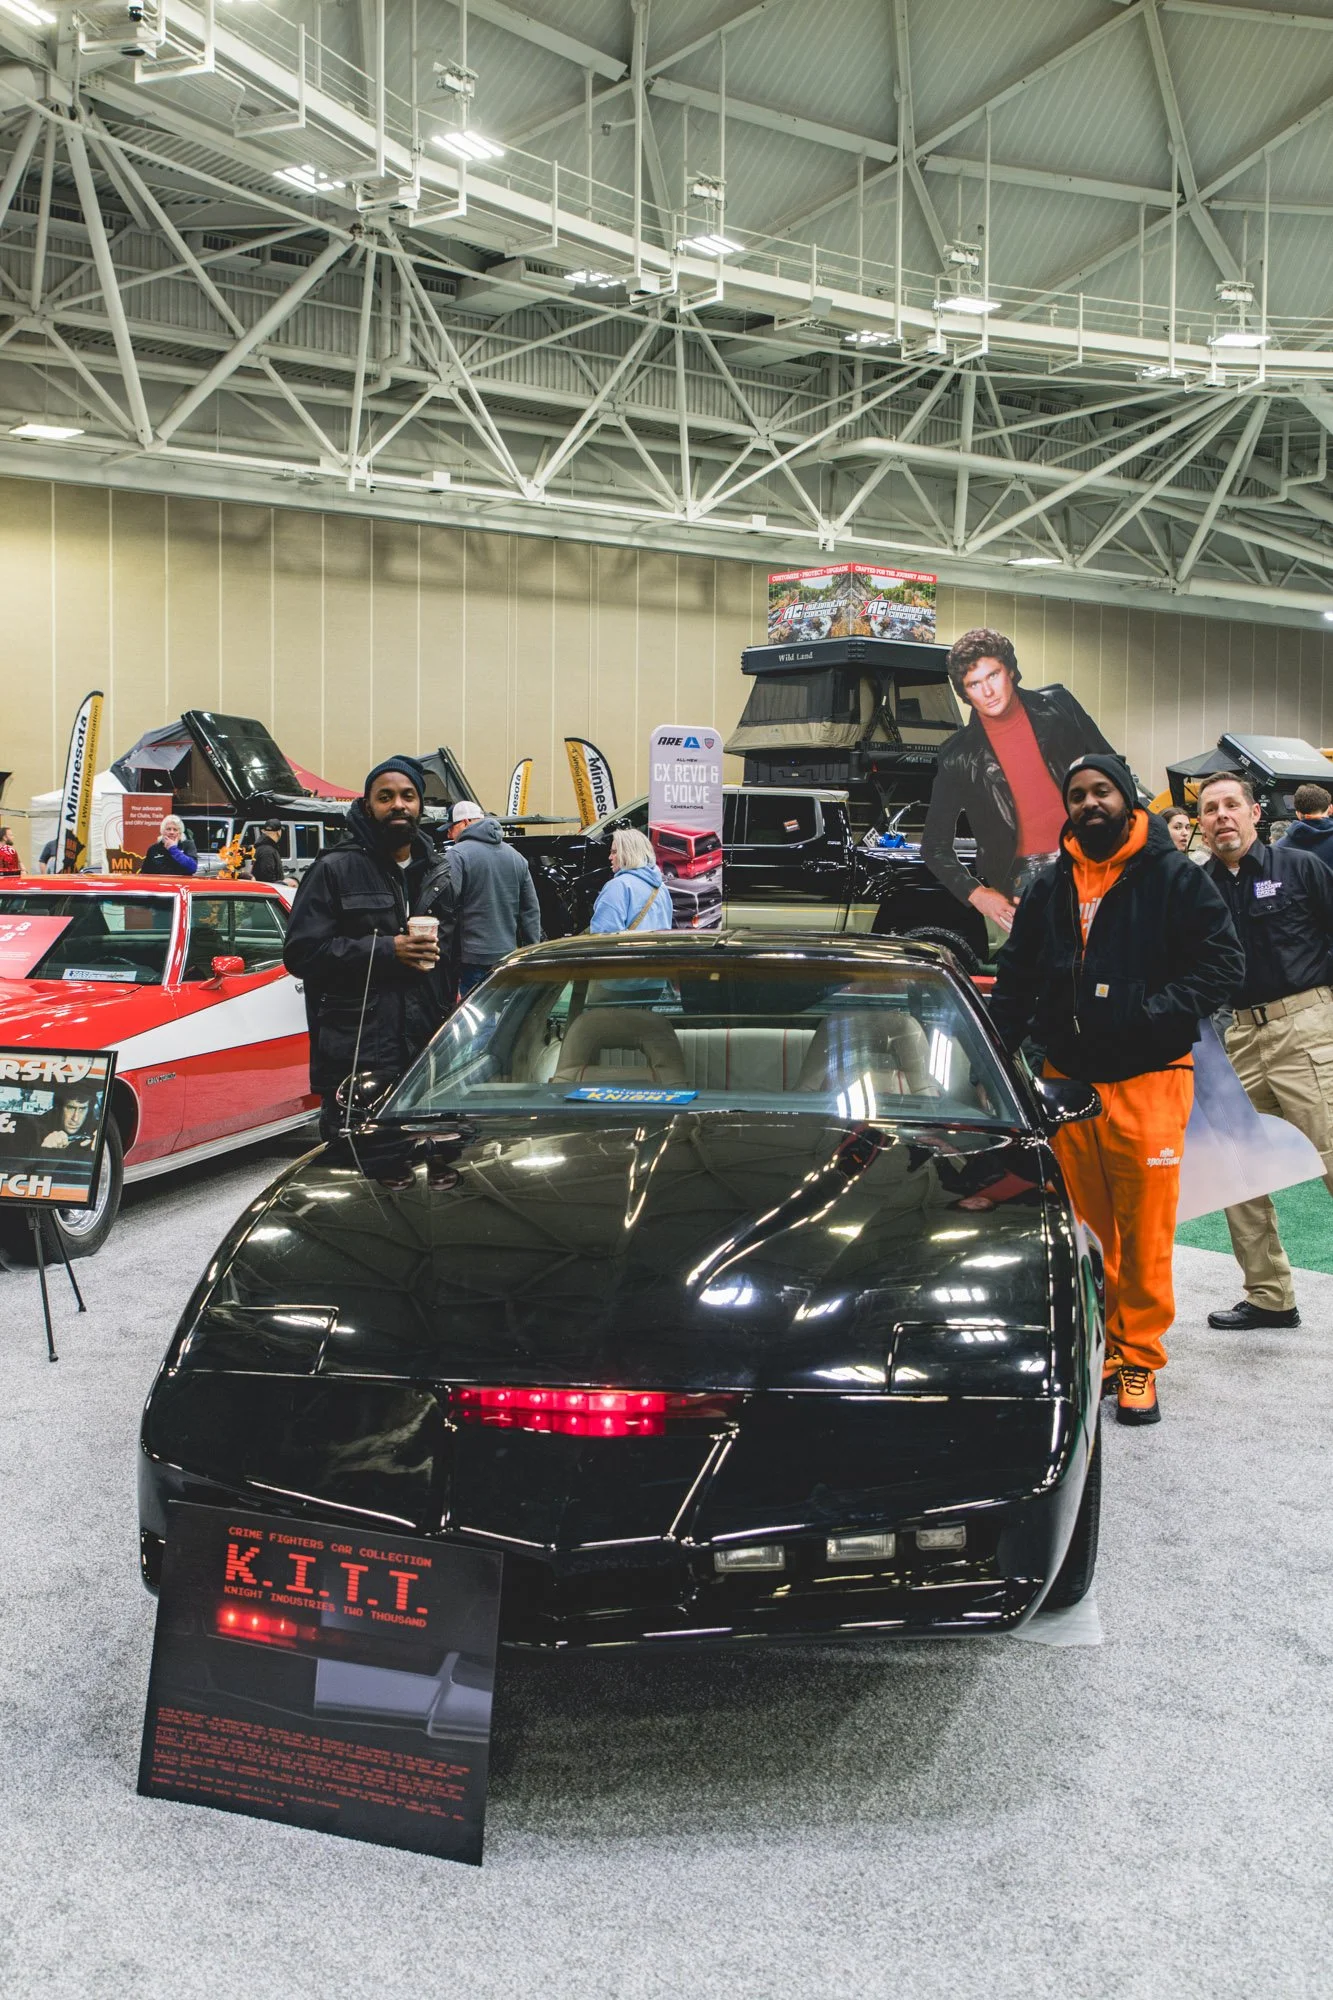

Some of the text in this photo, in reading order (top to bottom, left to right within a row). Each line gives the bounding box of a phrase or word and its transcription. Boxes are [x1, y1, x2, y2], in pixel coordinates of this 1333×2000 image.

[771, 565, 849, 583] CUSTOMIZE PROTECT UPGRADE
[854, 565, 876, 574] CRAFTED
[896, 571, 918, 580] JOURNEY
[917, 574, 934, 582] AHEAD
[778, 651, 814, 662] Wild Land
[658, 737, 684, 747] ARE
[65, 715, 88, 824] Minnesota
[82, 787, 91, 819] Wheel
[90, 705, 99, 761] Association
[572, 755, 581, 777] Wheel
[654, 763, 670, 783] CX
[674, 764, 709, 784] REVO
[576, 777, 585, 797] Drive
[664, 783, 711, 804] EVOLVE
[111, 858, 133, 870] MN
[586, 1092, 681, 1102] KNIGHT
[228, 1526, 433, 1568] CRIME FIGHTERS CAR COLLECTION
[225, 1543, 429, 1615] K.I.T.T.
[223, 1584, 427, 1629] KNIGHT INDUSTRIES TWO THOUSAND
